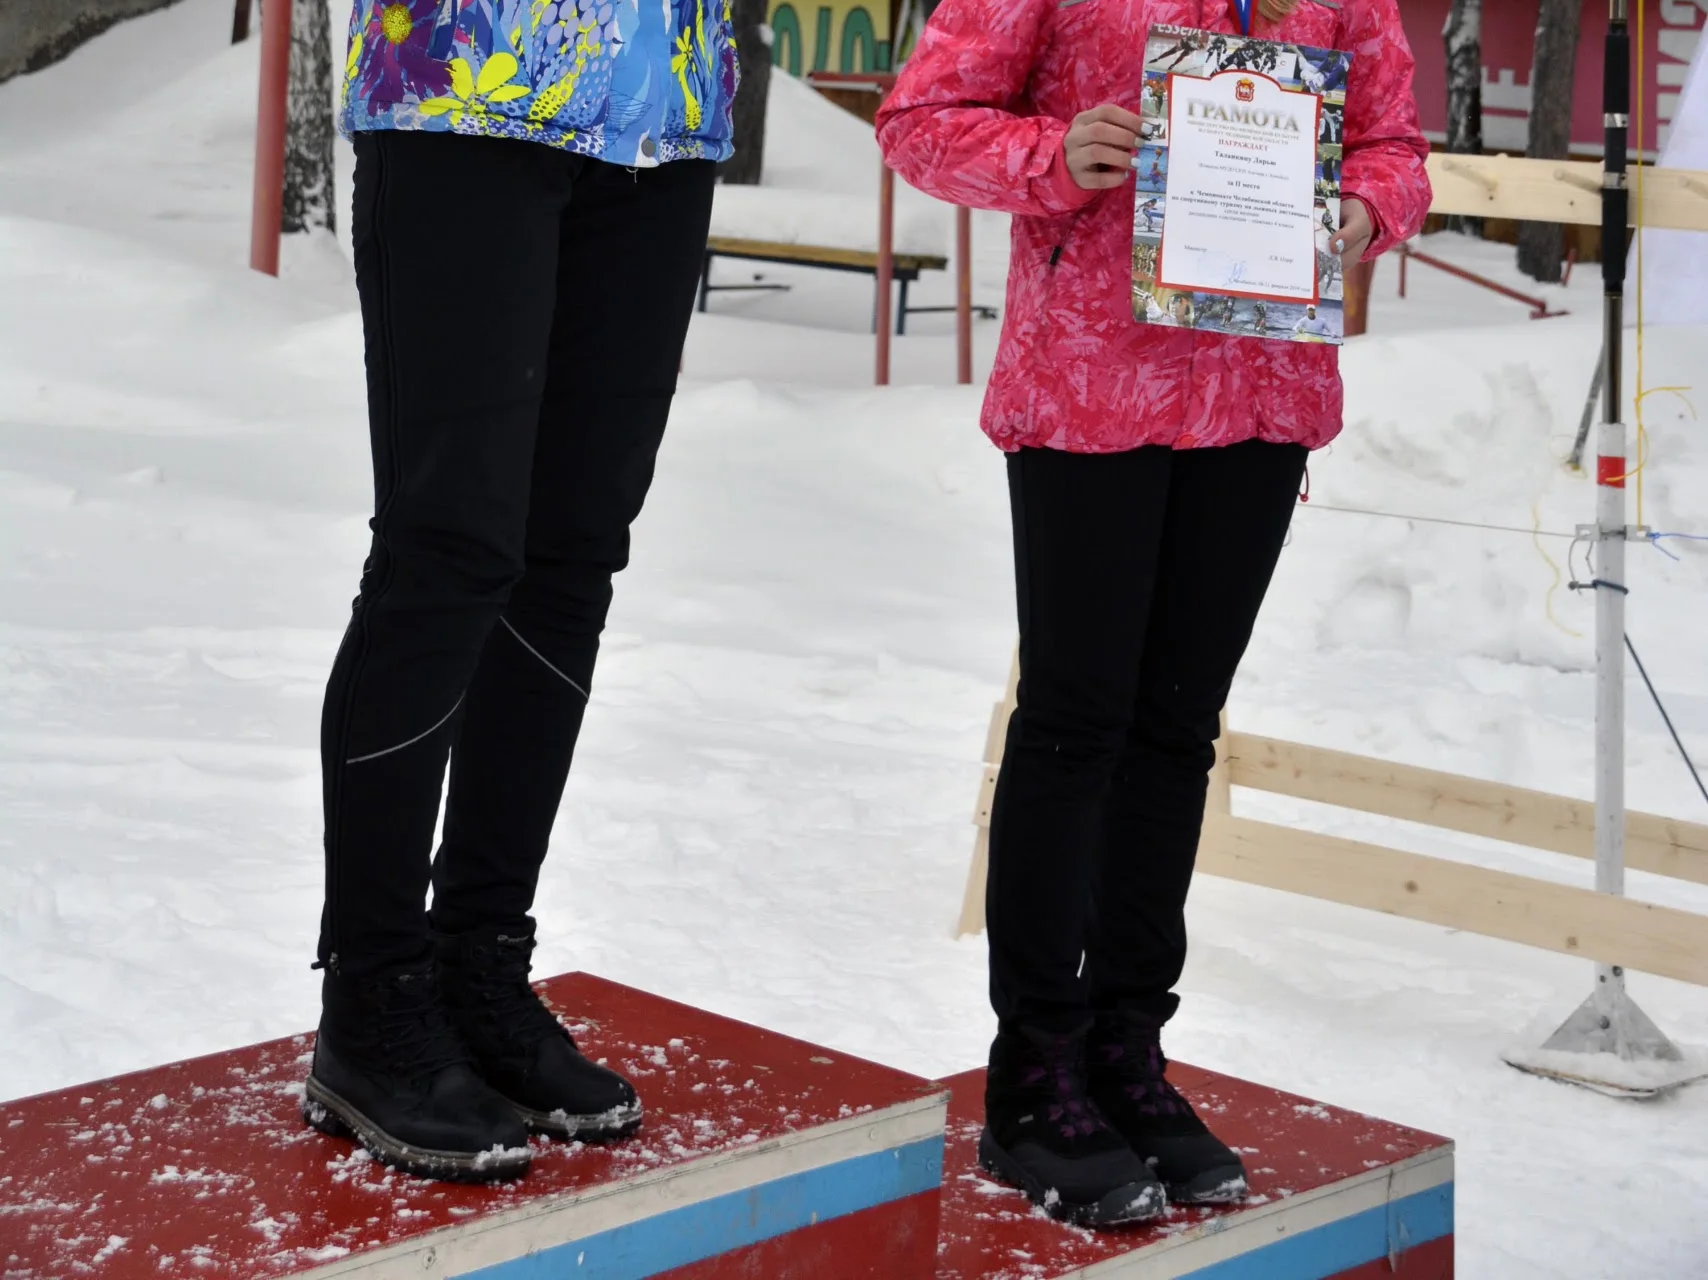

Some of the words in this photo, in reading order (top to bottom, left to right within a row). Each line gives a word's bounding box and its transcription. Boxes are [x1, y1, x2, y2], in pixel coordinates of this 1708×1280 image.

[1186, 98, 1300, 132] ГРАМОТА
[1218, 138, 1268, 152] НАГРАЖДАЕТ
[1254, 156, 1276, 166] Дарью
[1242, 182, 1260, 190] место
[1197, 190, 1232, 200] Чемпионате
[1233, 194, 1271, 205] Челябинской
[1272, 200, 1294, 208] области
